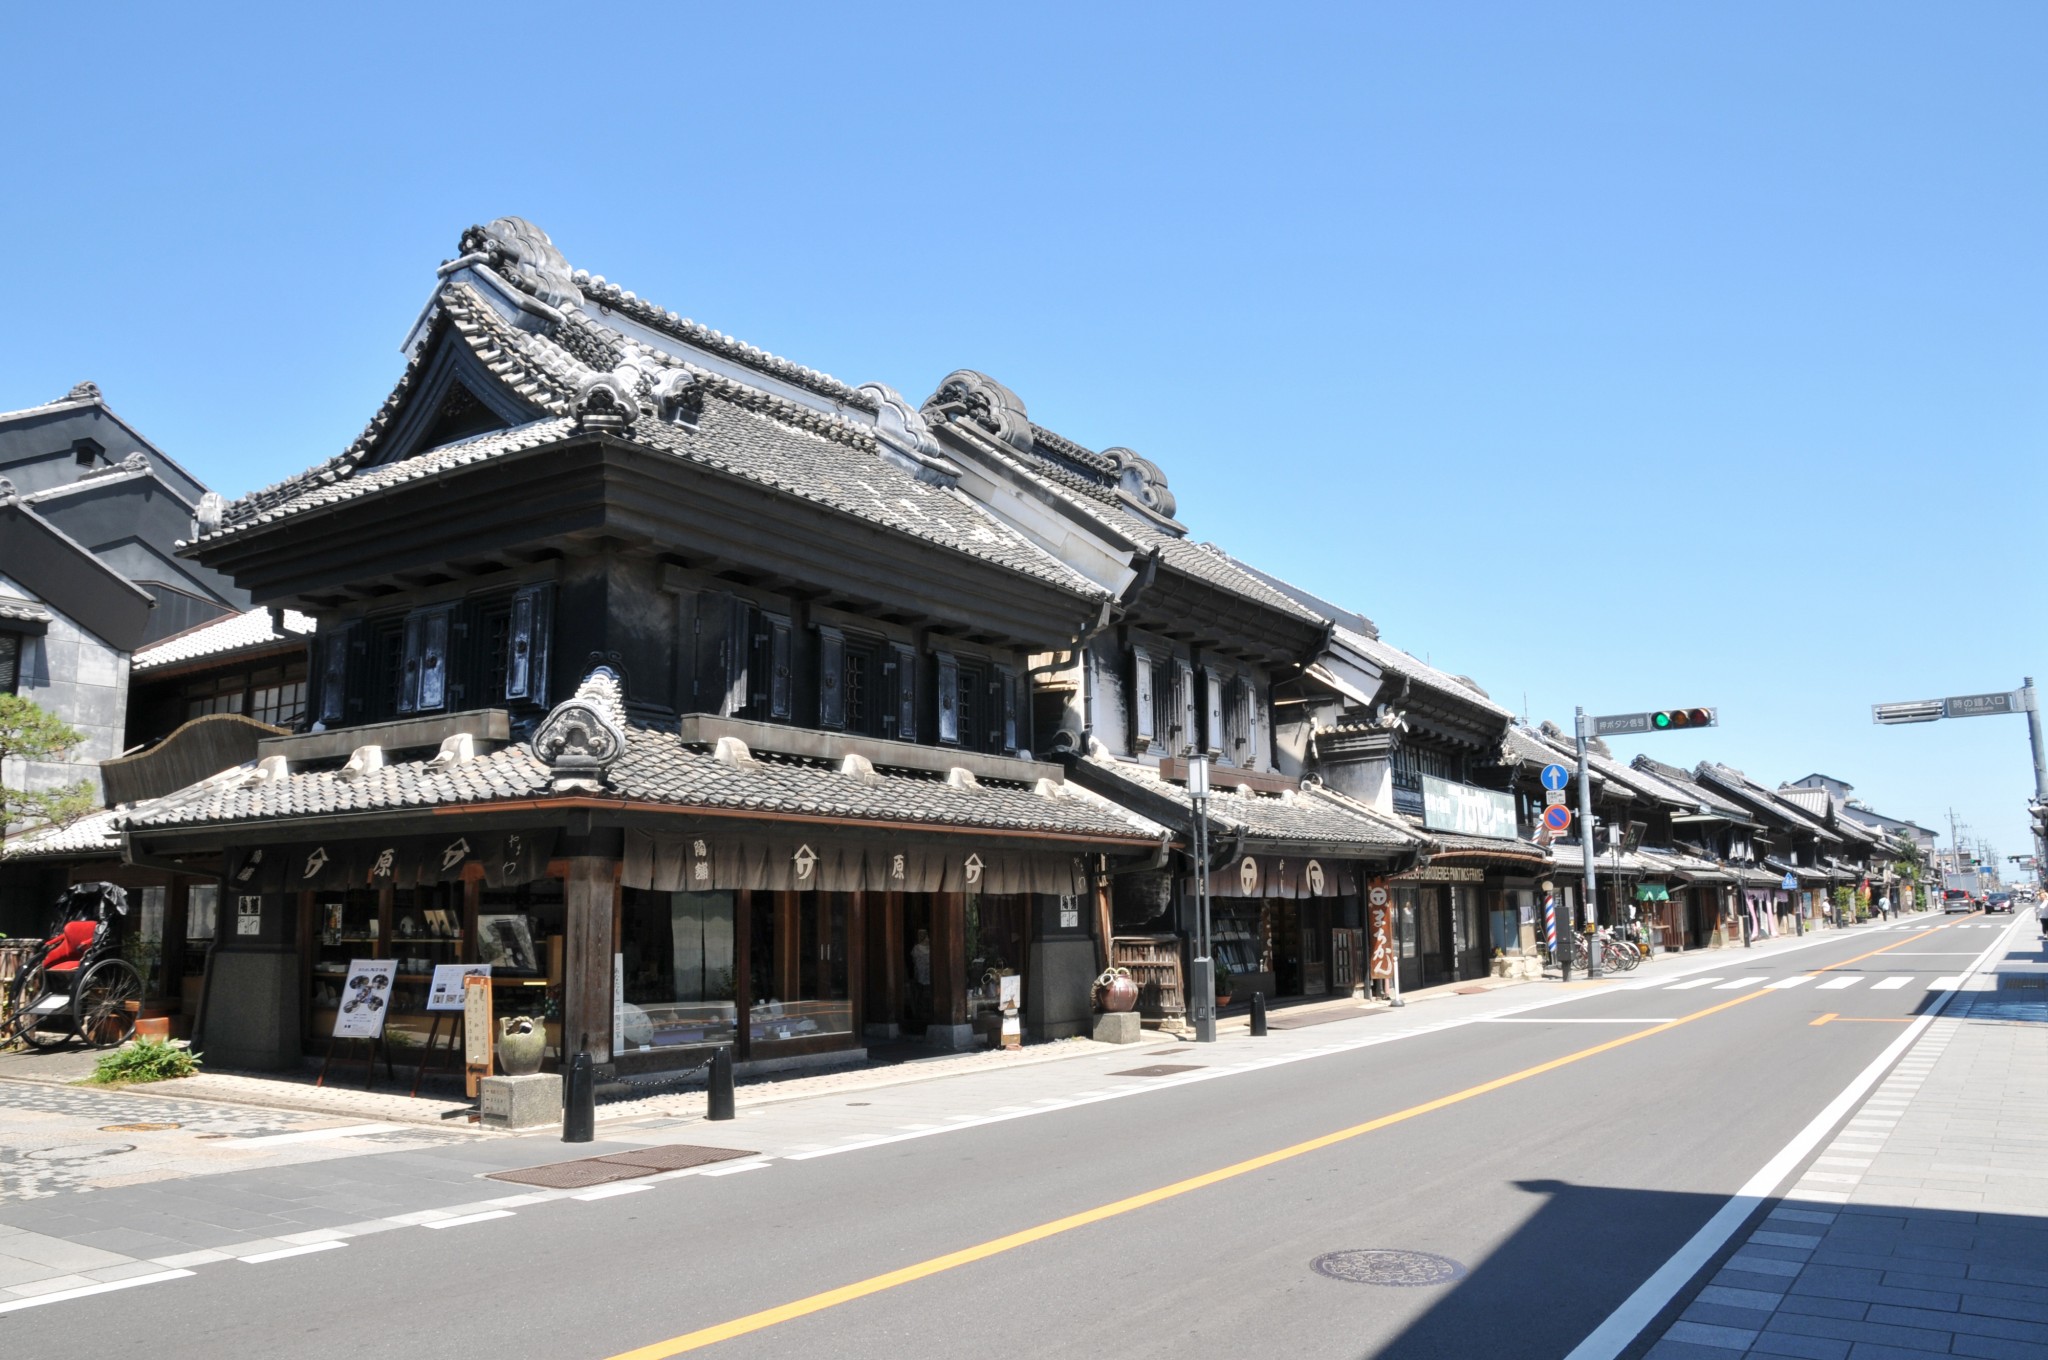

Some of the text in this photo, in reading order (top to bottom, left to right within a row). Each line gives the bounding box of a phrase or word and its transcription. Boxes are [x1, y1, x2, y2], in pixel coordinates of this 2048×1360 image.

[1952, 696, 2005, 709] 時の鐘入口
[1599, 717, 1645, 730] 押ボタン信号
[373, 848, 395, 877] 原
[891, 854, 905, 880] 原
[1373, 909, 1393, 975] まちかん
